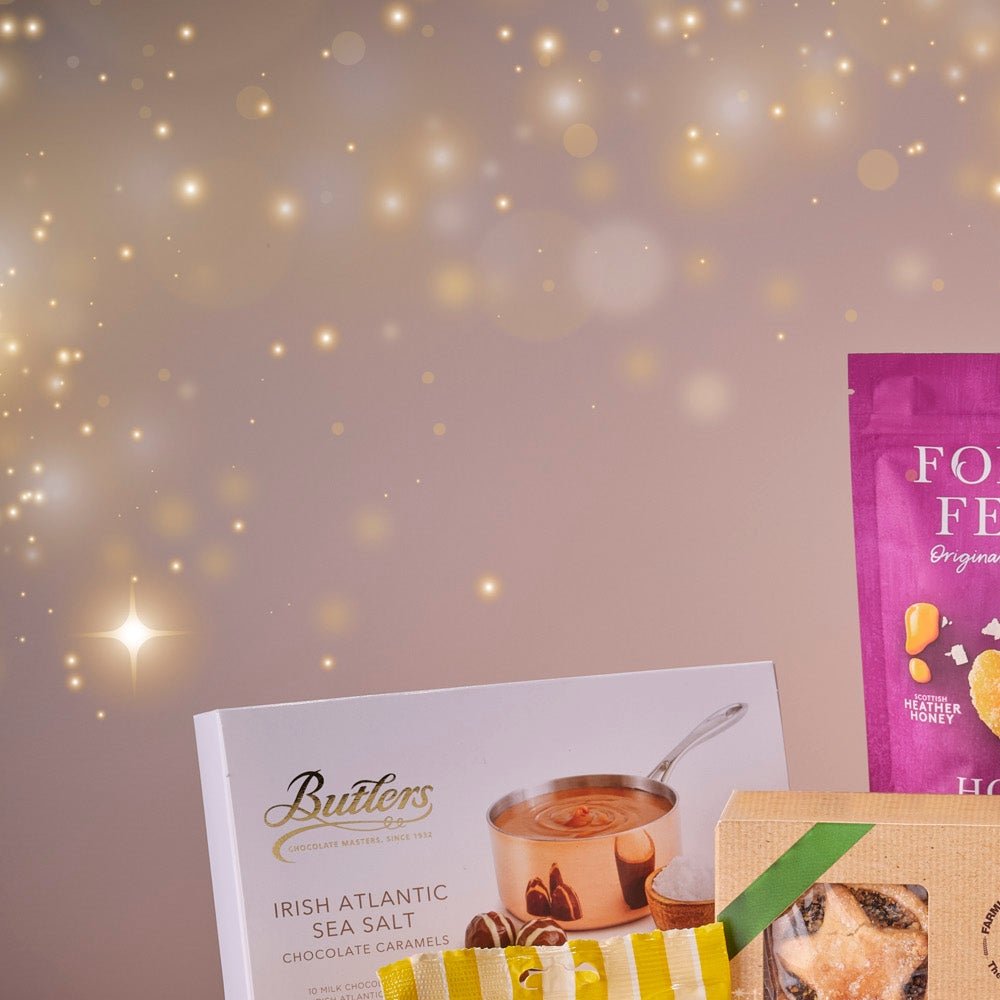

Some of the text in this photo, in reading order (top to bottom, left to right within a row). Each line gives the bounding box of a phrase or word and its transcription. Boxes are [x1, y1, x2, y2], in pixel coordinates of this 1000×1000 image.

[904, 698, 962, 714] HEATHER
[914, 693, 948, 702] SCOTTISH
[910, 710, 955, 725] HONEY
[264, 769, 434, 832] Butlers
[288, 840, 339, 853] CHOCOLATE
[386, 833, 411, 843] SINCE
[413, 831, 433, 840] 1932
[273, 884, 449, 919] IRISH ATLANTIC
[312, 912, 415, 938] SEA SALT
[282, 934, 450, 964] CHOCOLATE CARAMELS
[320, 984, 342, 994] MILK
